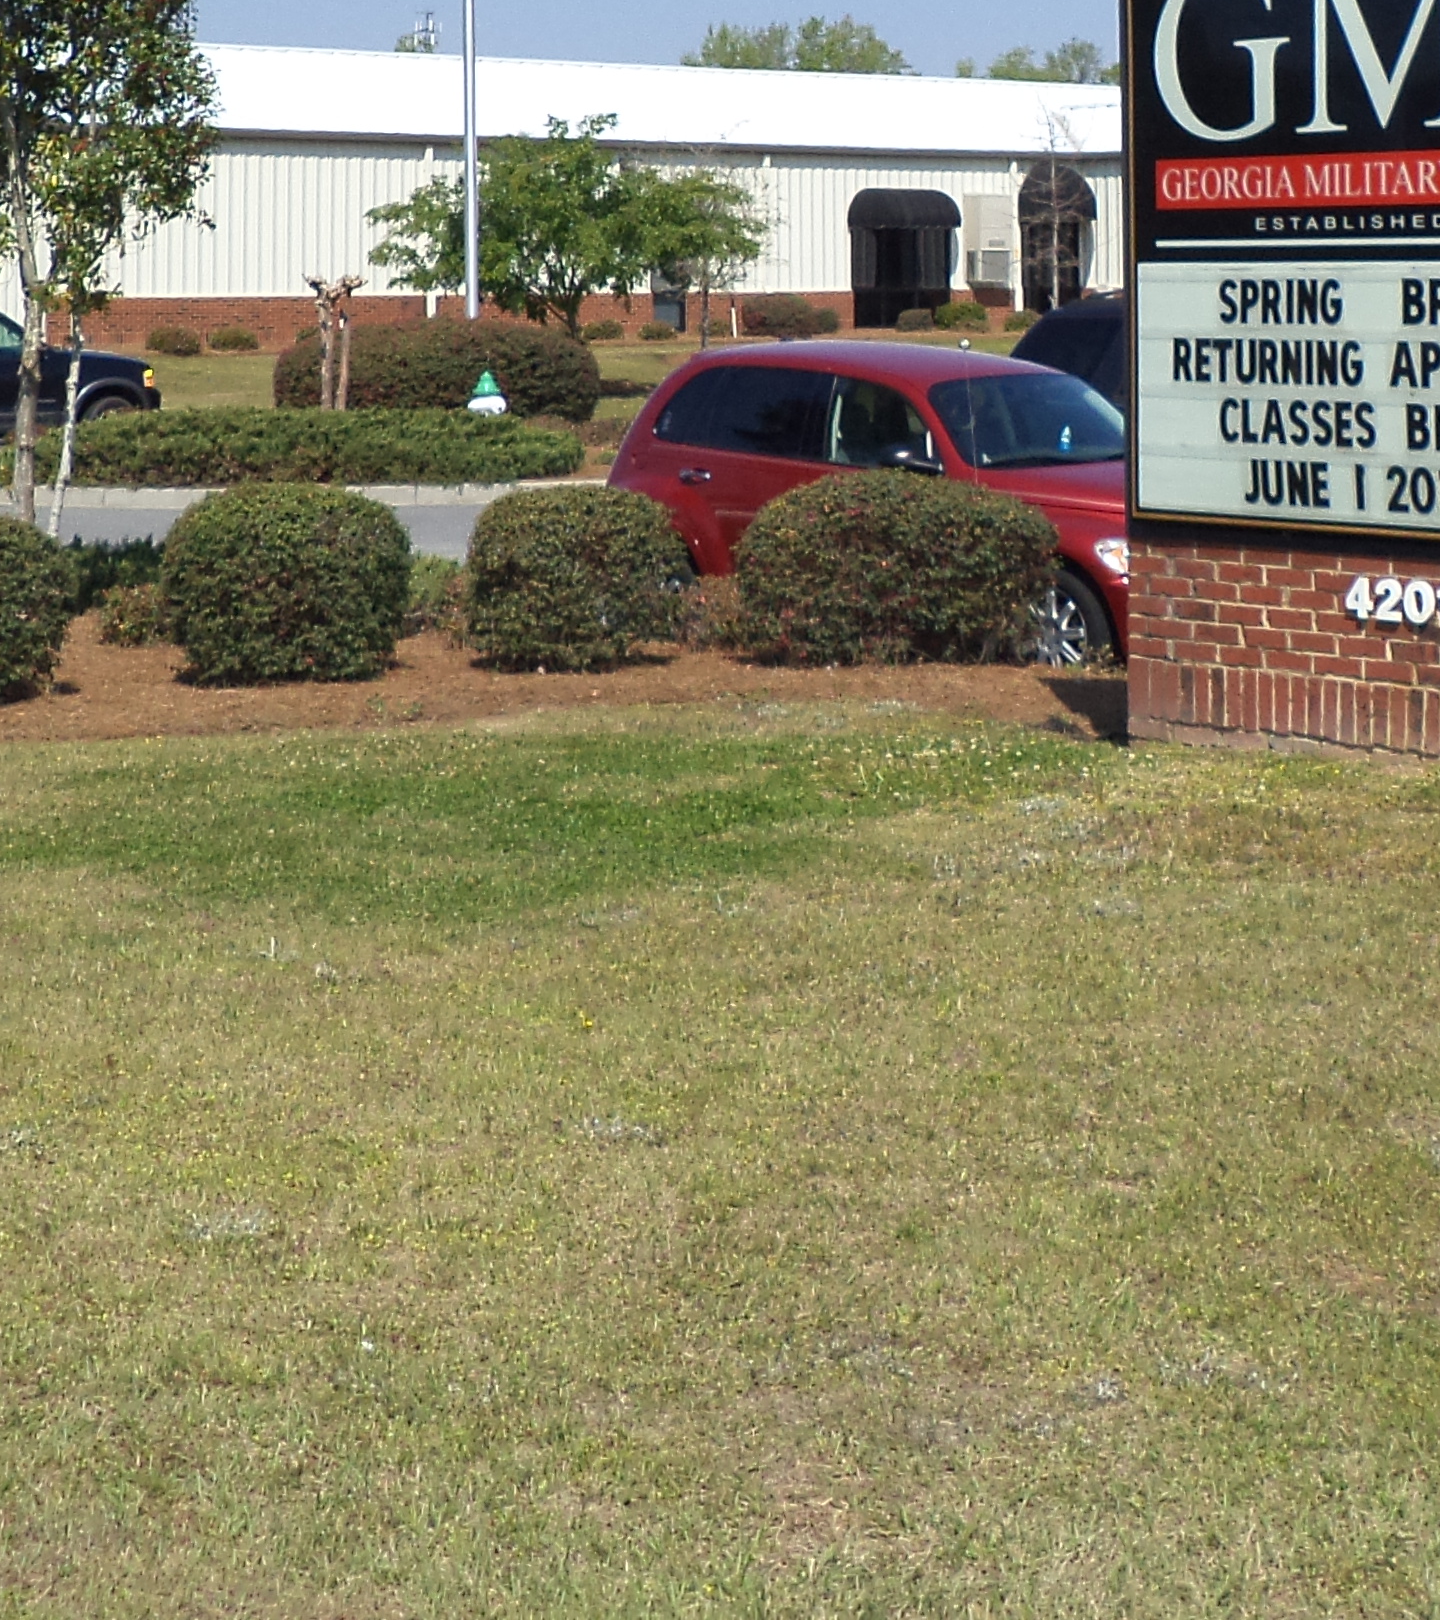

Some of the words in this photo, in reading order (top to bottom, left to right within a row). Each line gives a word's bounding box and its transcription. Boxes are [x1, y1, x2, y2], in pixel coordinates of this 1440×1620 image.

[1162, 166, 1295, 201] GEORGIA
[1219, 278, 1343, 325] SPRING
[1173, 337, 1364, 387] RETURNING
[1219, 397, 1376, 449] CLASSES
[1244, 458, 1331, 509] JUNE
